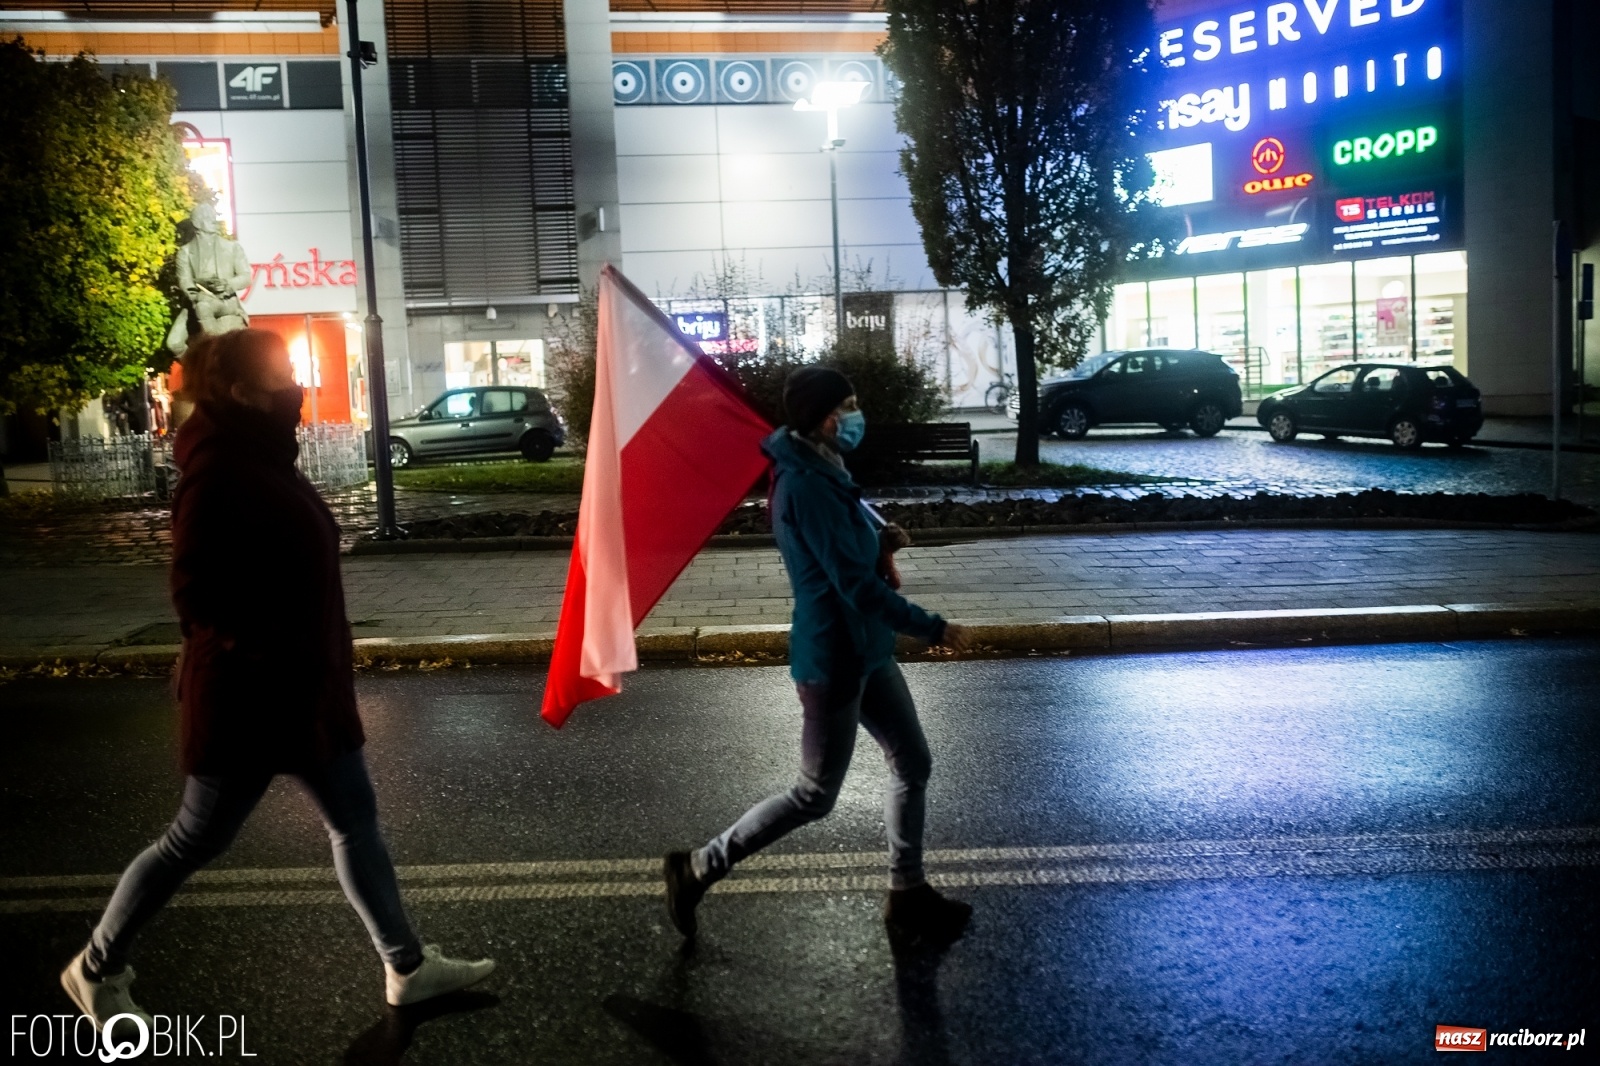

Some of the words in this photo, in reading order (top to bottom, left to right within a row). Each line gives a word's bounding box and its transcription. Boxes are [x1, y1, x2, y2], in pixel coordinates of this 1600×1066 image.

[1158, 0, 1426, 67] ESERVE
[229, 66, 278, 91] 4F
[1333, 126, 1438, 165] CROPP
[1365, 191, 1435, 210] TELKOM
[240, 248, 357, 302] yńska
